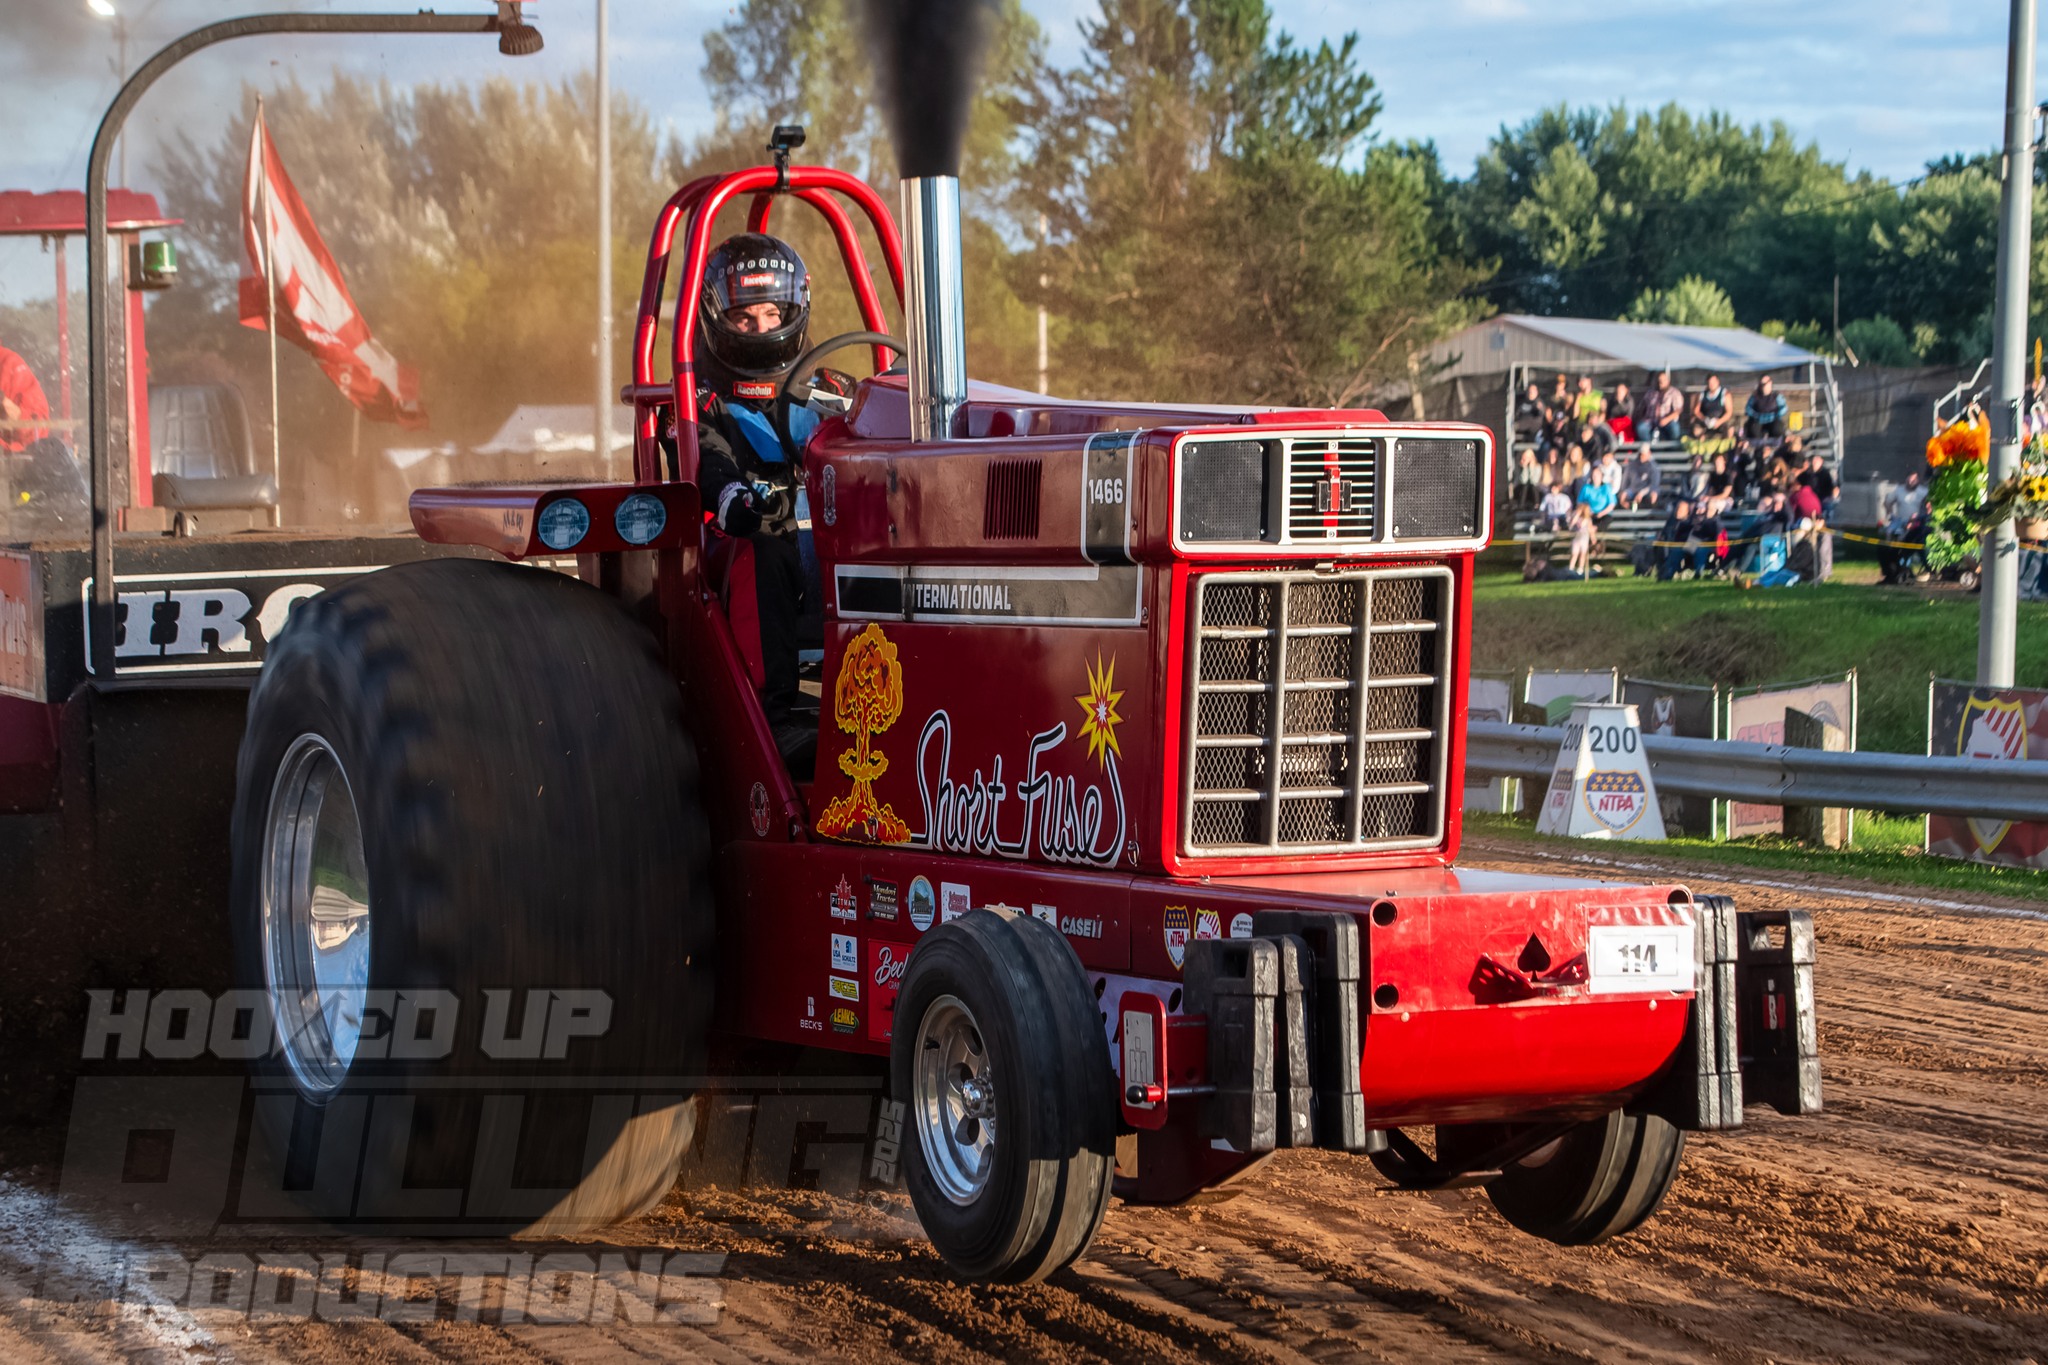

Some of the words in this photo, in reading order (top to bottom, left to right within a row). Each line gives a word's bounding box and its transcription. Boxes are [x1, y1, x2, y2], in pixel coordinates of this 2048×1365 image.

[737, 384, 772, 397] RaceQuip
[1088, 478, 1123, 504] 1466
[903, 583, 1012, 611] TERNATIONAL
[1562, 723, 1585, 751] 200
[1588, 725, 1637, 754] 200
[908, 709, 1008, 859] Short
[1017, 720, 1126, 869] Fuse
[1598, 794, 1635, 812] NTPA
[832, 897, 856, 907] PITTMAN
[1170, 930, 1185, 948] NTPA
[1617, 944, 1658, 973] 114
[800, 1018, 823, 1031] BECK'S
[833, 1008, 855, 1025] LEMKE
